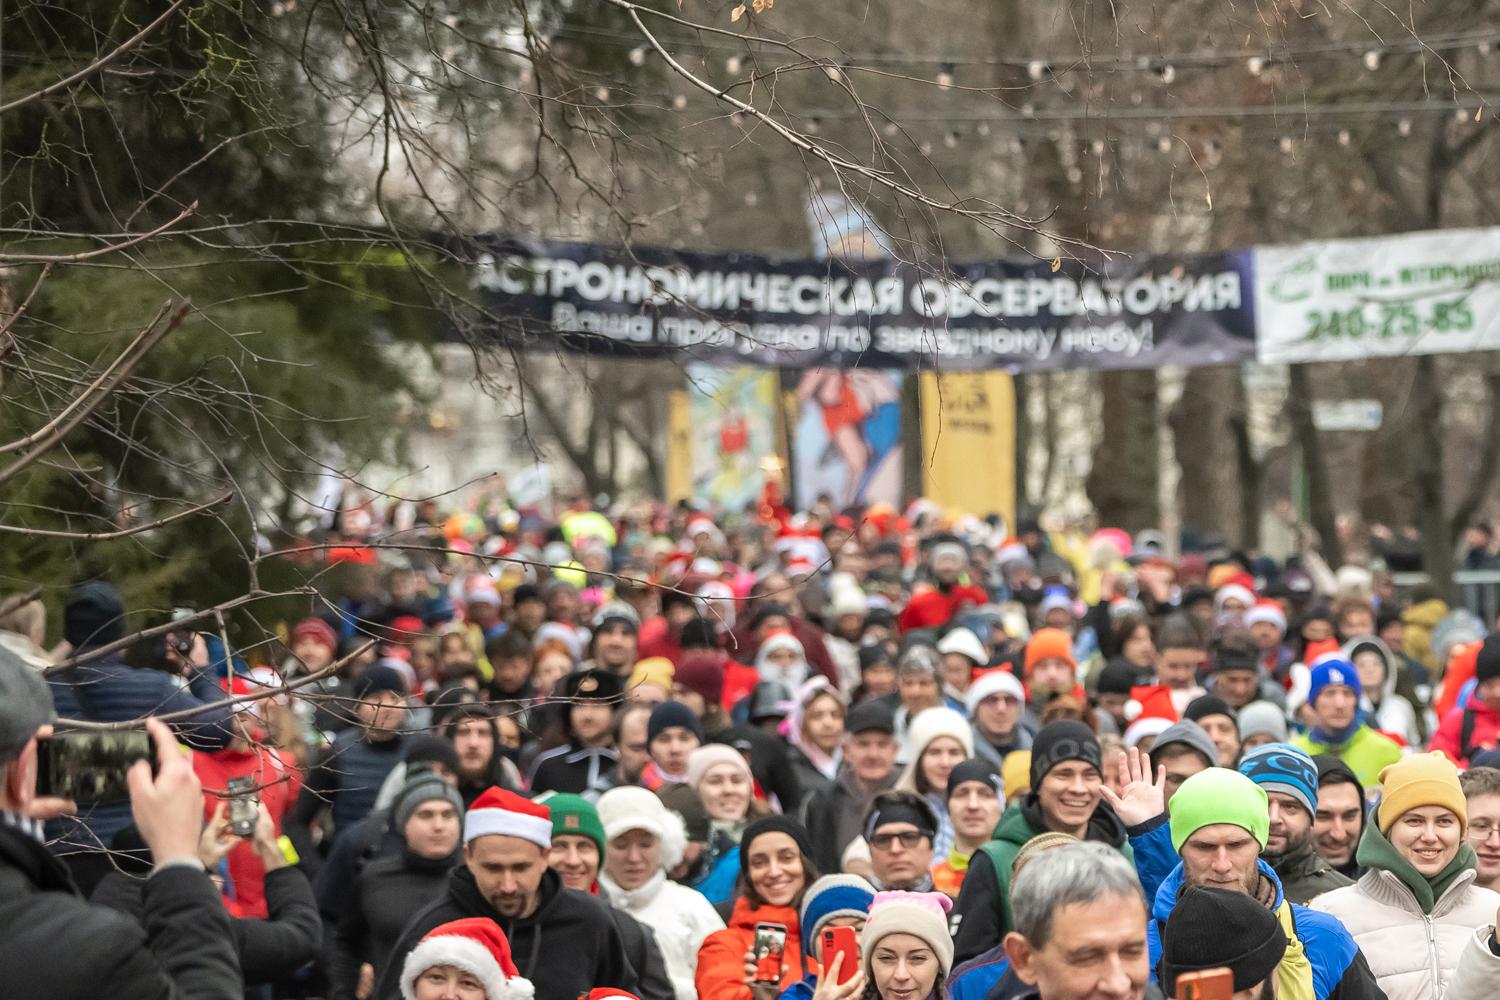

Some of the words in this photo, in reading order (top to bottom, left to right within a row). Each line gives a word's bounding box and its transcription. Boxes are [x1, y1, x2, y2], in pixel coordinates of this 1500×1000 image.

[468, 253, 904, 317] АСТРОНОМИЧЕСКАЯ
[910, 271, 1242, 319] ОБСЕРВАТОРИЯ
[552, 301, 653, 343] Ваша
[825, 324, 871, 353] по
[1061, 319, 1154, 359] небу!
